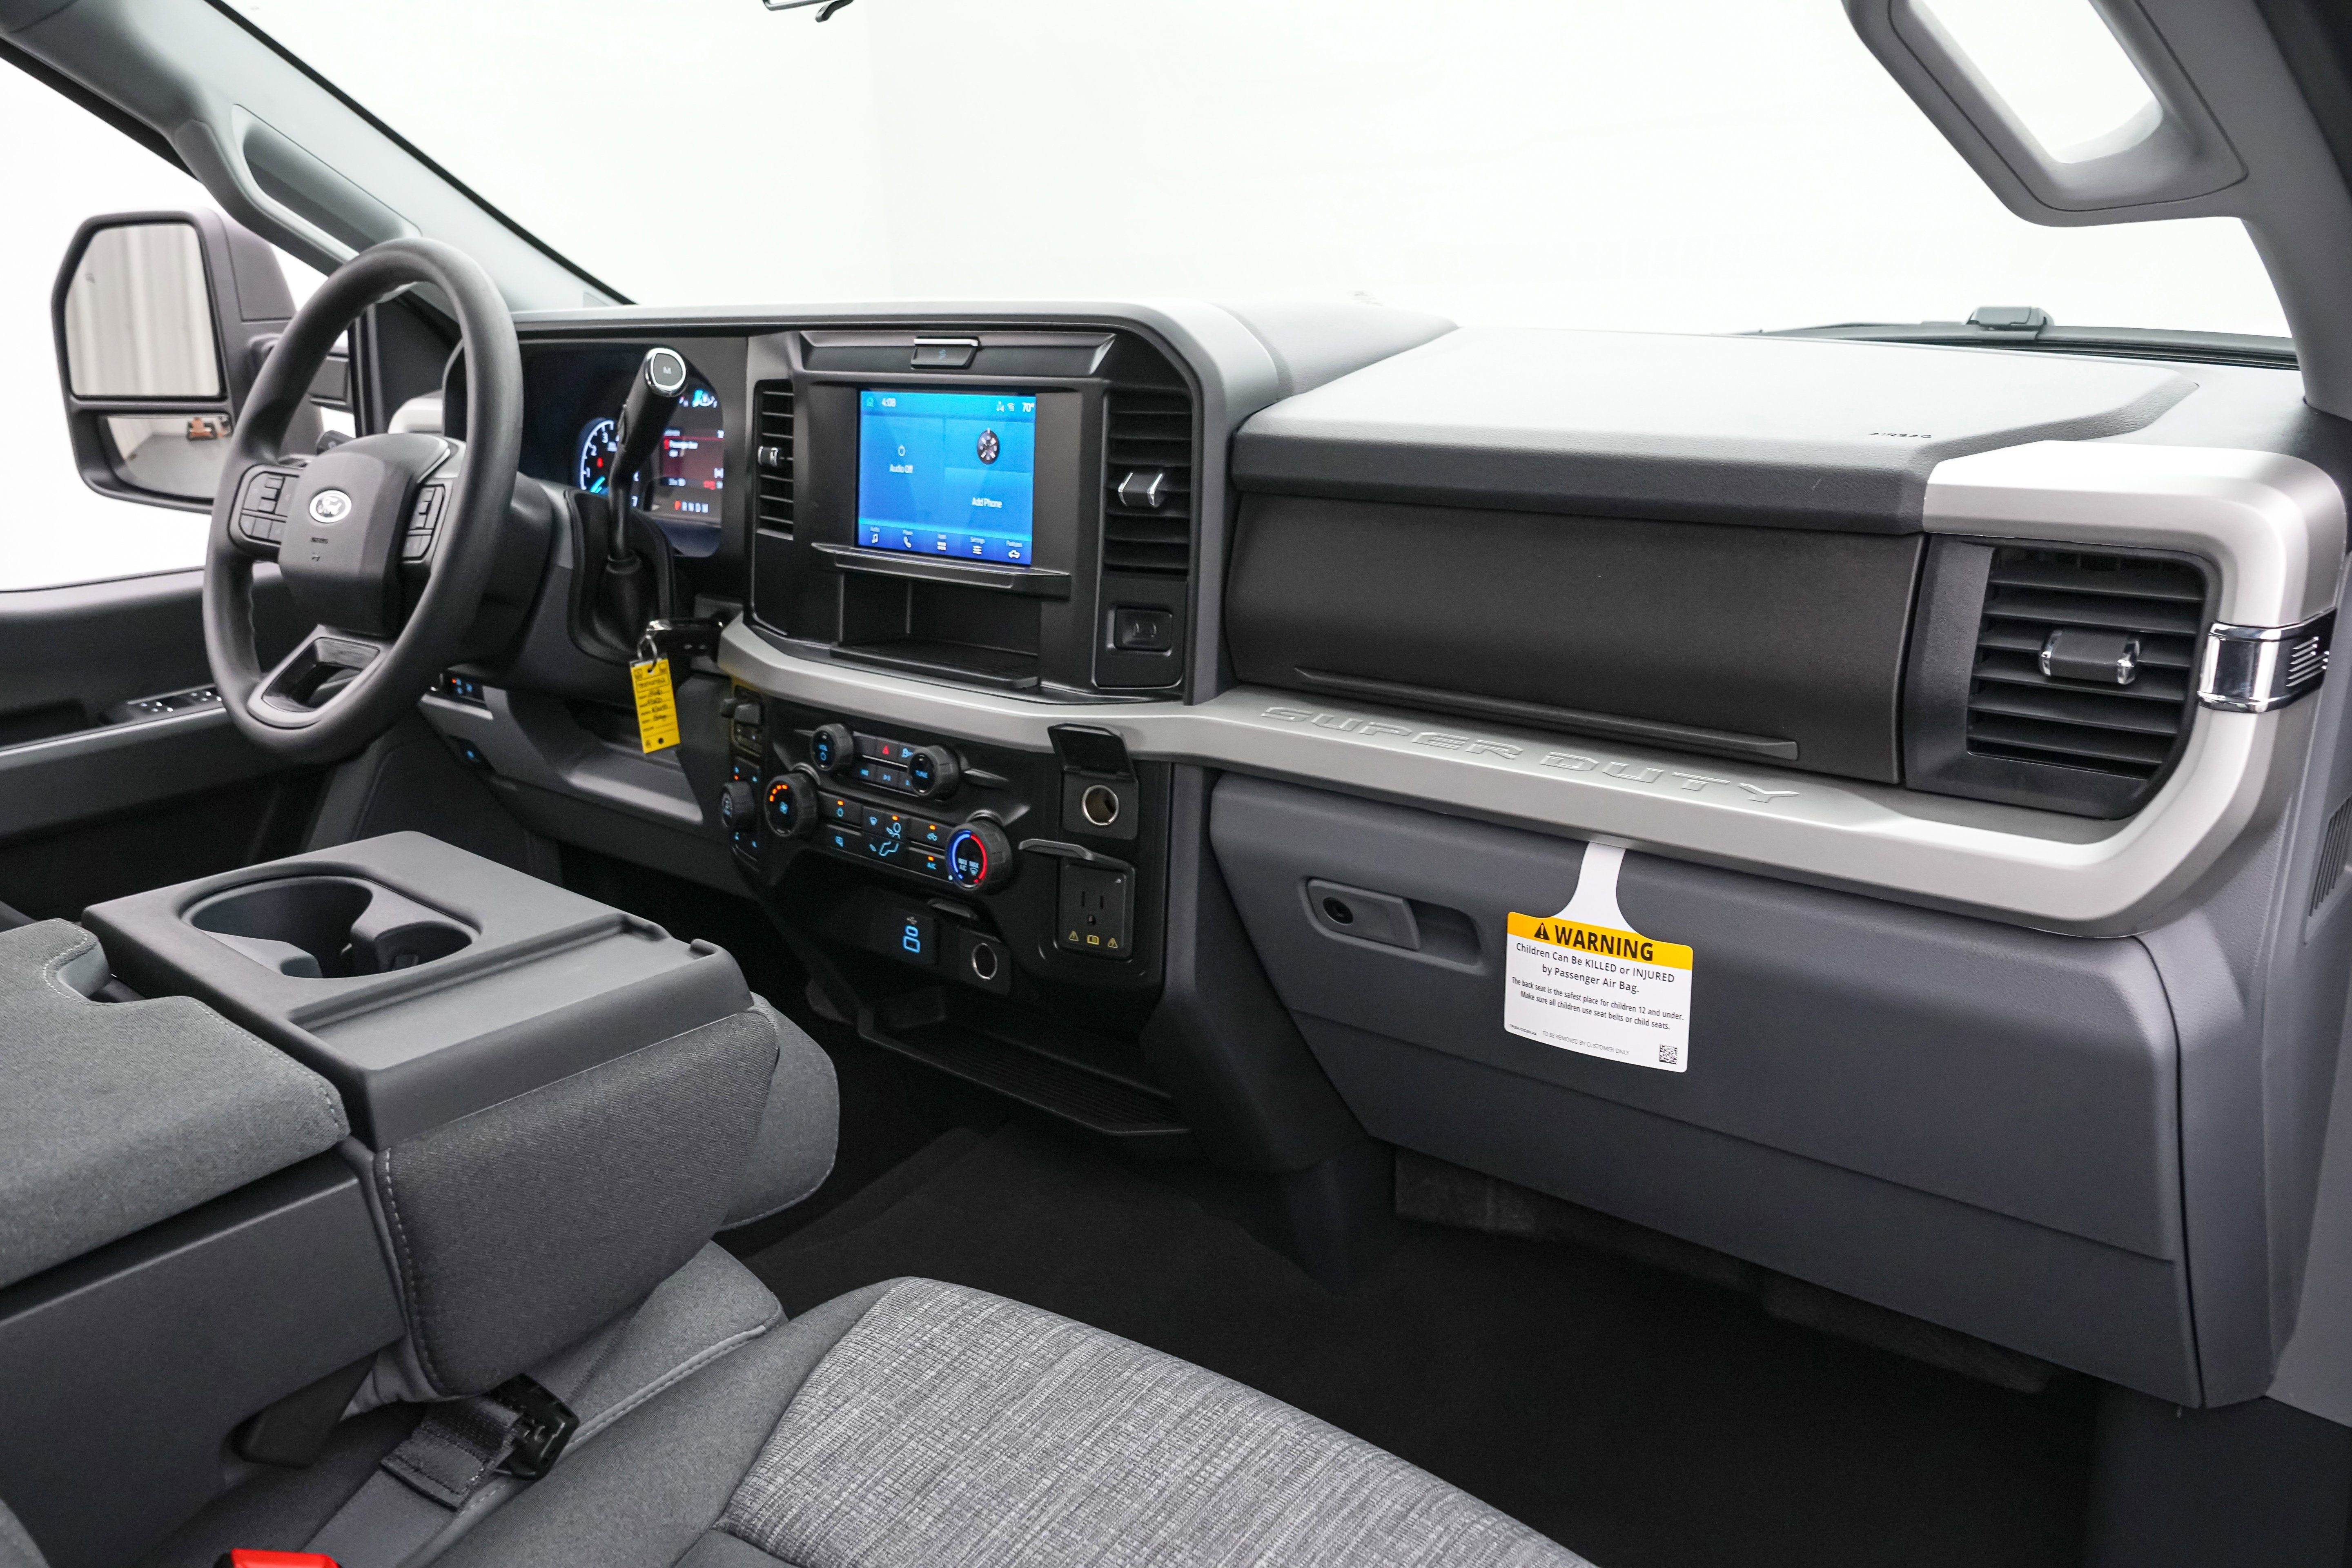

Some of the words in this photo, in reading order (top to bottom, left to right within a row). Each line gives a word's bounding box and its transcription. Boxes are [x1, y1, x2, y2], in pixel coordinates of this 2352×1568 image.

[971, 497, 983, 506] Add
[984, 498, 1002, 508] Phone
[1261, 705, 1524, 760] SUPER
[1538, 750, 1800, 803] DUTY
[1555, 925, 1653, 961] WARNING
[1517, 942, 1550, 959] Children
[1552, 952, 1568, 963] Can
[1571, 956, 1583, 966] Be
[1585, 959, 1616, 972] KILLED
[1633, 968, 1675, 982] INJURED
[1542, 964, 1552, 976] by
[1555, 967, 1600, 985] Passenger
[1602, 978, 1617, 988] Air
[1619, 981, 1639, 994] Bag.
[1512, 977, 1521, 985] The
[1522, 980, 1534, 989] back
[1554, 989, 1563, 997] the
[1564, 992, 1581, 1001] safest
[1583, 996, 1598, 1005] place
[1600, 999, 1609, 1007] for
[1611, 1001, 1636, 1012] children
[1662, 1011, 1684, 1020] under.
[1521, 991, 1535, 1001] Make
[1557, 1001, 1580, 1012] children
[1594, 1010, 1606, 1018] seat
[1608, 1012, 1624, 1021] belts
[1634, 1017, 1649, 1026] child
[1651, 1021, 1670, 1030] seats.
[1556, 1034, 1579, 1044] REMOVED
[1587, 1042, 1615, 1053] CUSTOMER
[1615, 1047, 1630, 1056] ONLY
